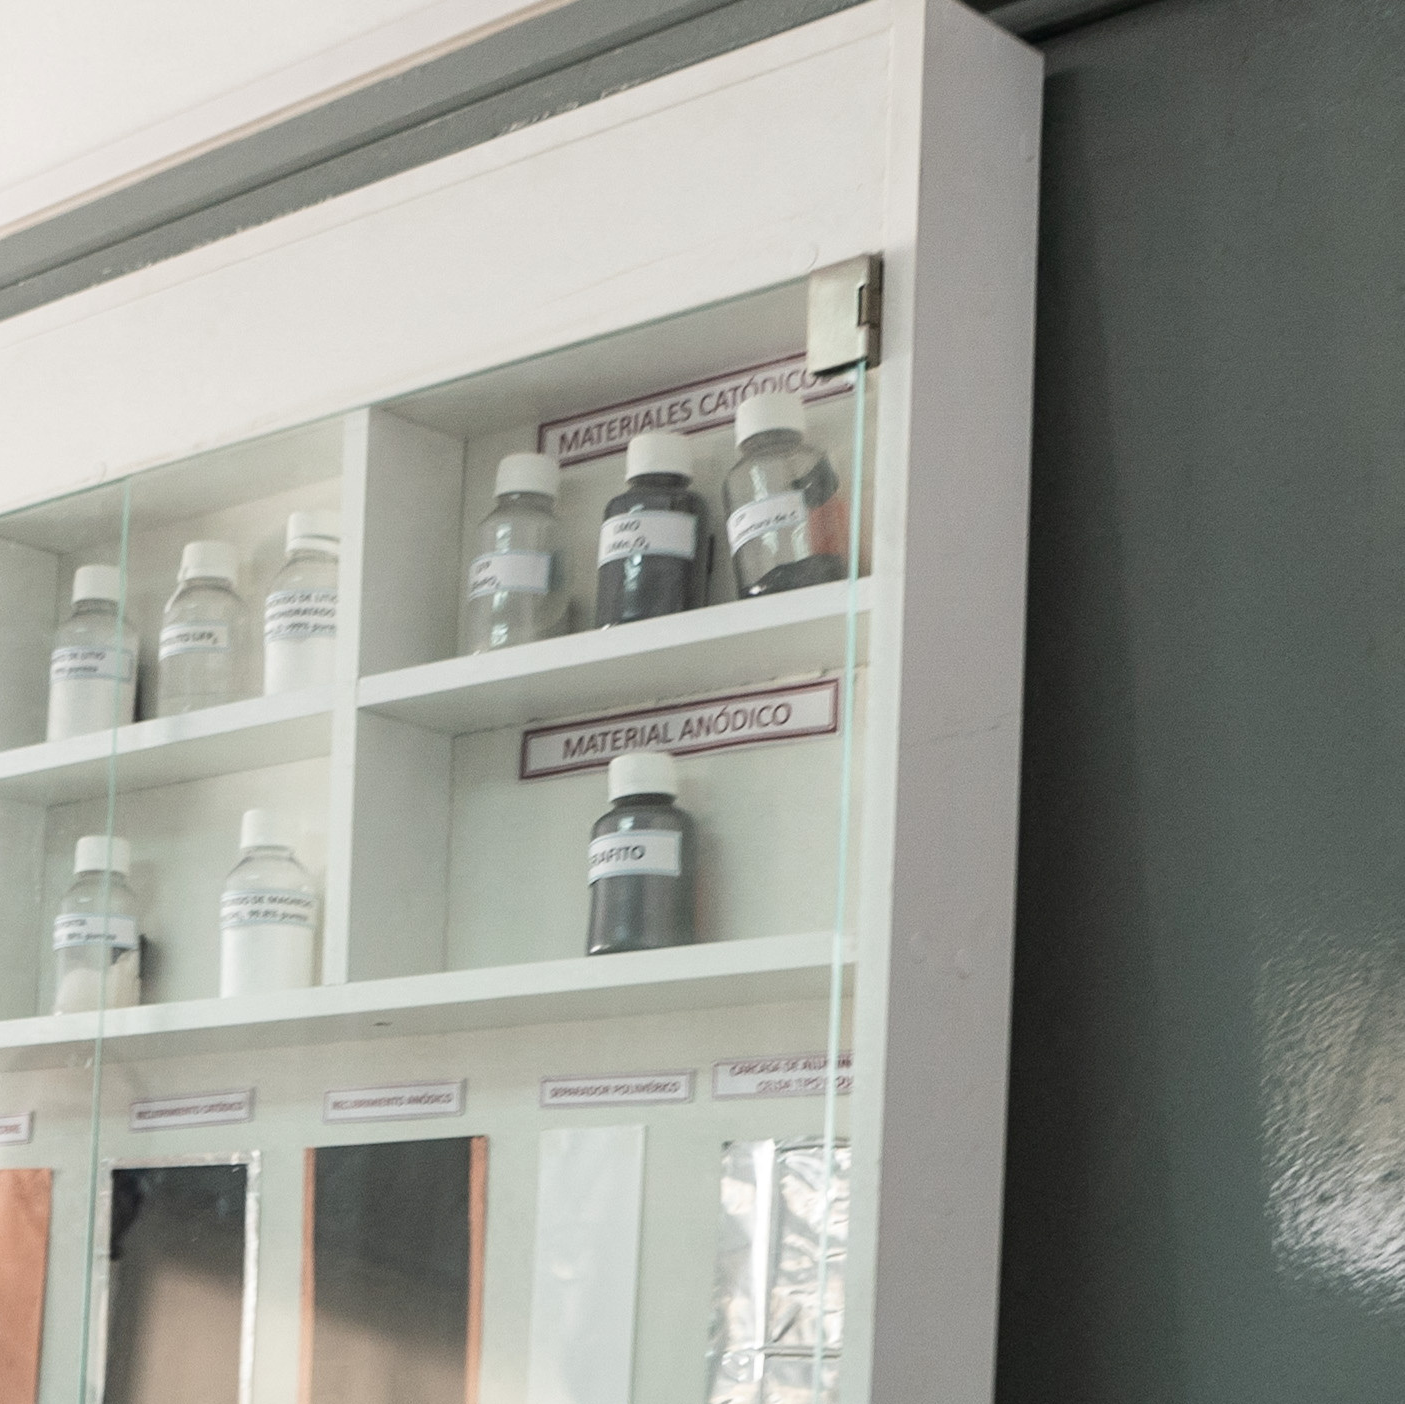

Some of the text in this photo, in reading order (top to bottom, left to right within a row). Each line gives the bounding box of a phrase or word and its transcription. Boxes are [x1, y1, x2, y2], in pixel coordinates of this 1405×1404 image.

[558, 367, 832, 454] MATERIALES CATÓDICO
[562, 702, 792, 760] MATERIAL ANÓDICO
[589, 845, 646, 866] RAFITO
